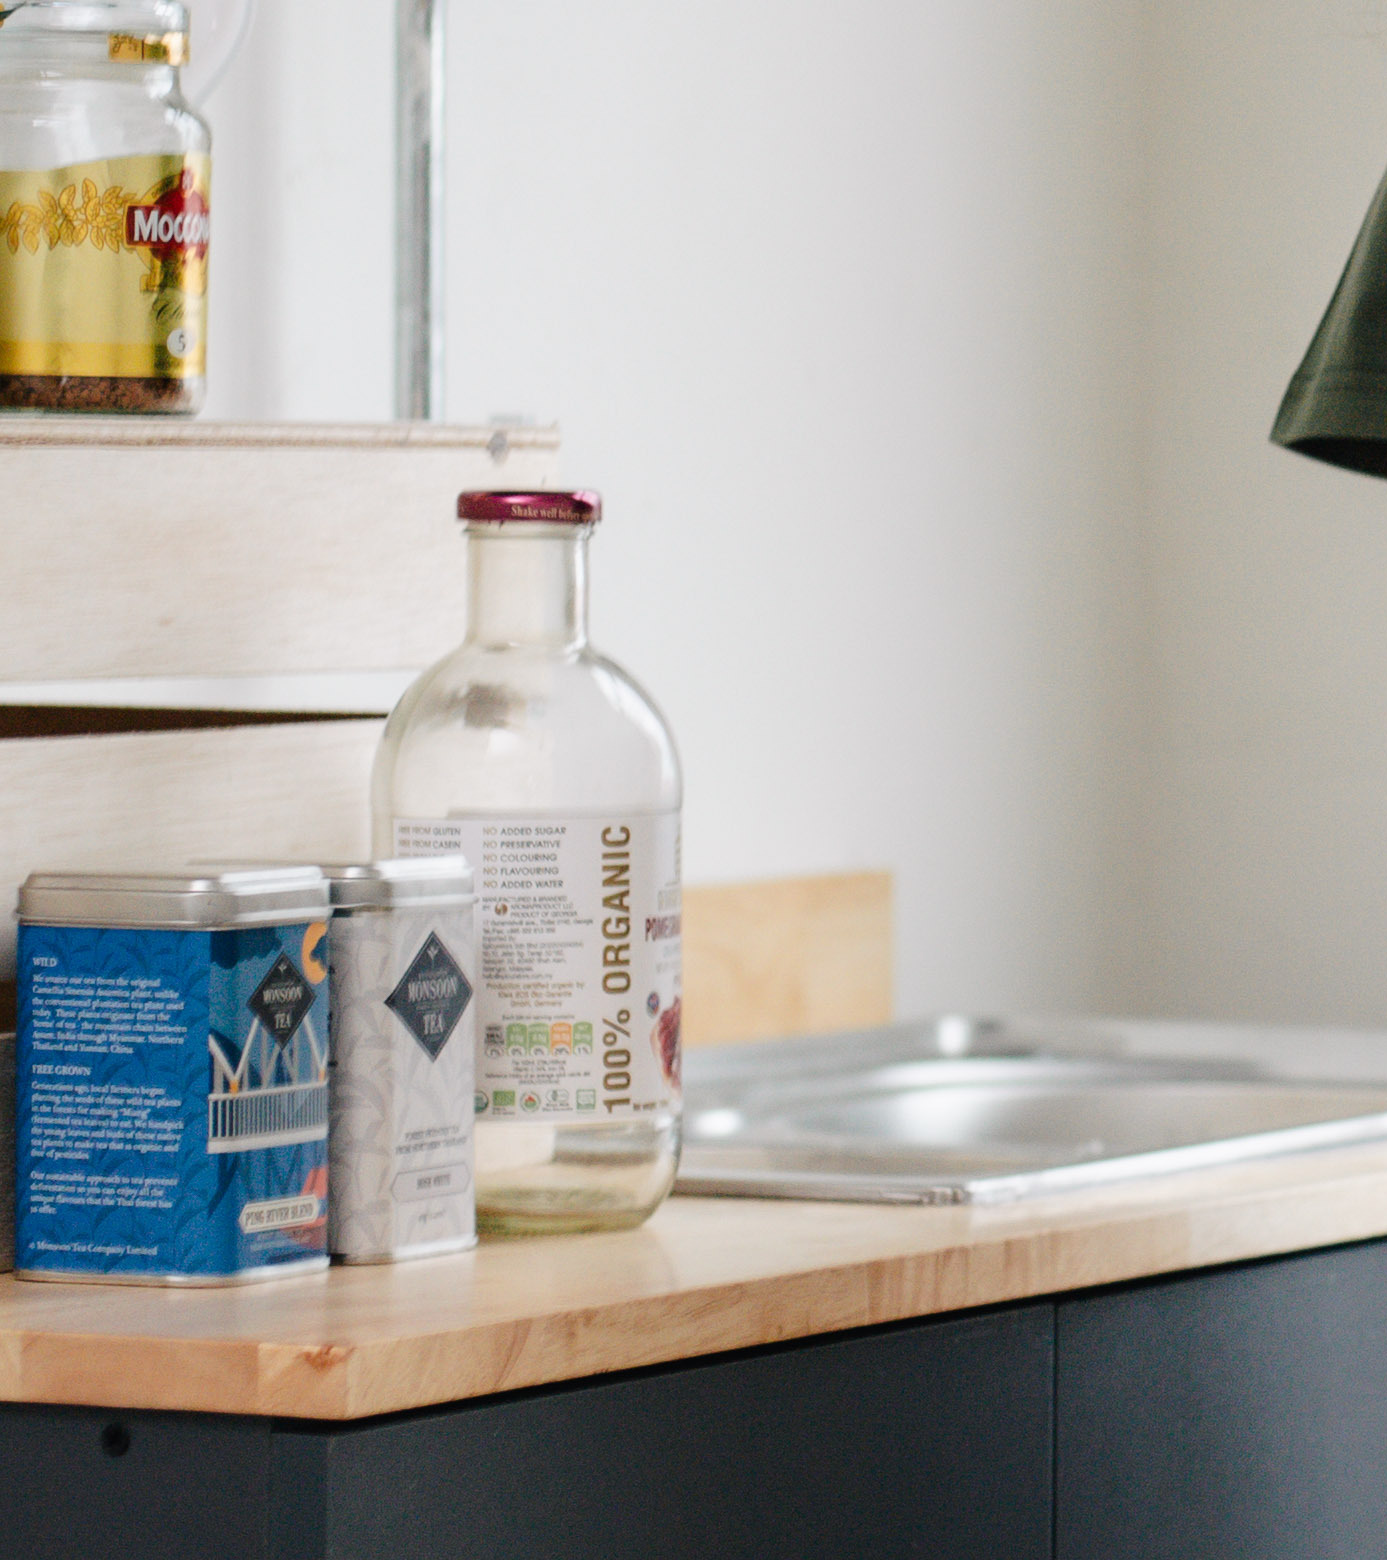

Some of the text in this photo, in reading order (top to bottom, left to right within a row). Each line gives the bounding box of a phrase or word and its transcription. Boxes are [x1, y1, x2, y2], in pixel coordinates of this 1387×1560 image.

[511, 504, 539, 518] Shake
[540, 507, 558, 519] well
[432, 827, 461, 836] GLUTEN
[483, 827, 567, 836] NO ADDED SUGAR
[432, 840, 461, 849] CASEIN
[483, 840, 561, 849] NO PRESERVATIVE
[483, 853, 558, 862] NO COLOURING
[483, 867, 559, 876] NO FLAVOURING
[483, 880, 564, 889] NO ADDED WATER
[33, 957, 58, 967] WILD
[602, 825, 631, 1113] 100% ORGANIC
[408, 975, 458, 1002] MONSOON
[423, 1012, 444, 1035] TEA
[32, 1065, 91, 1076] FREE GROWN
